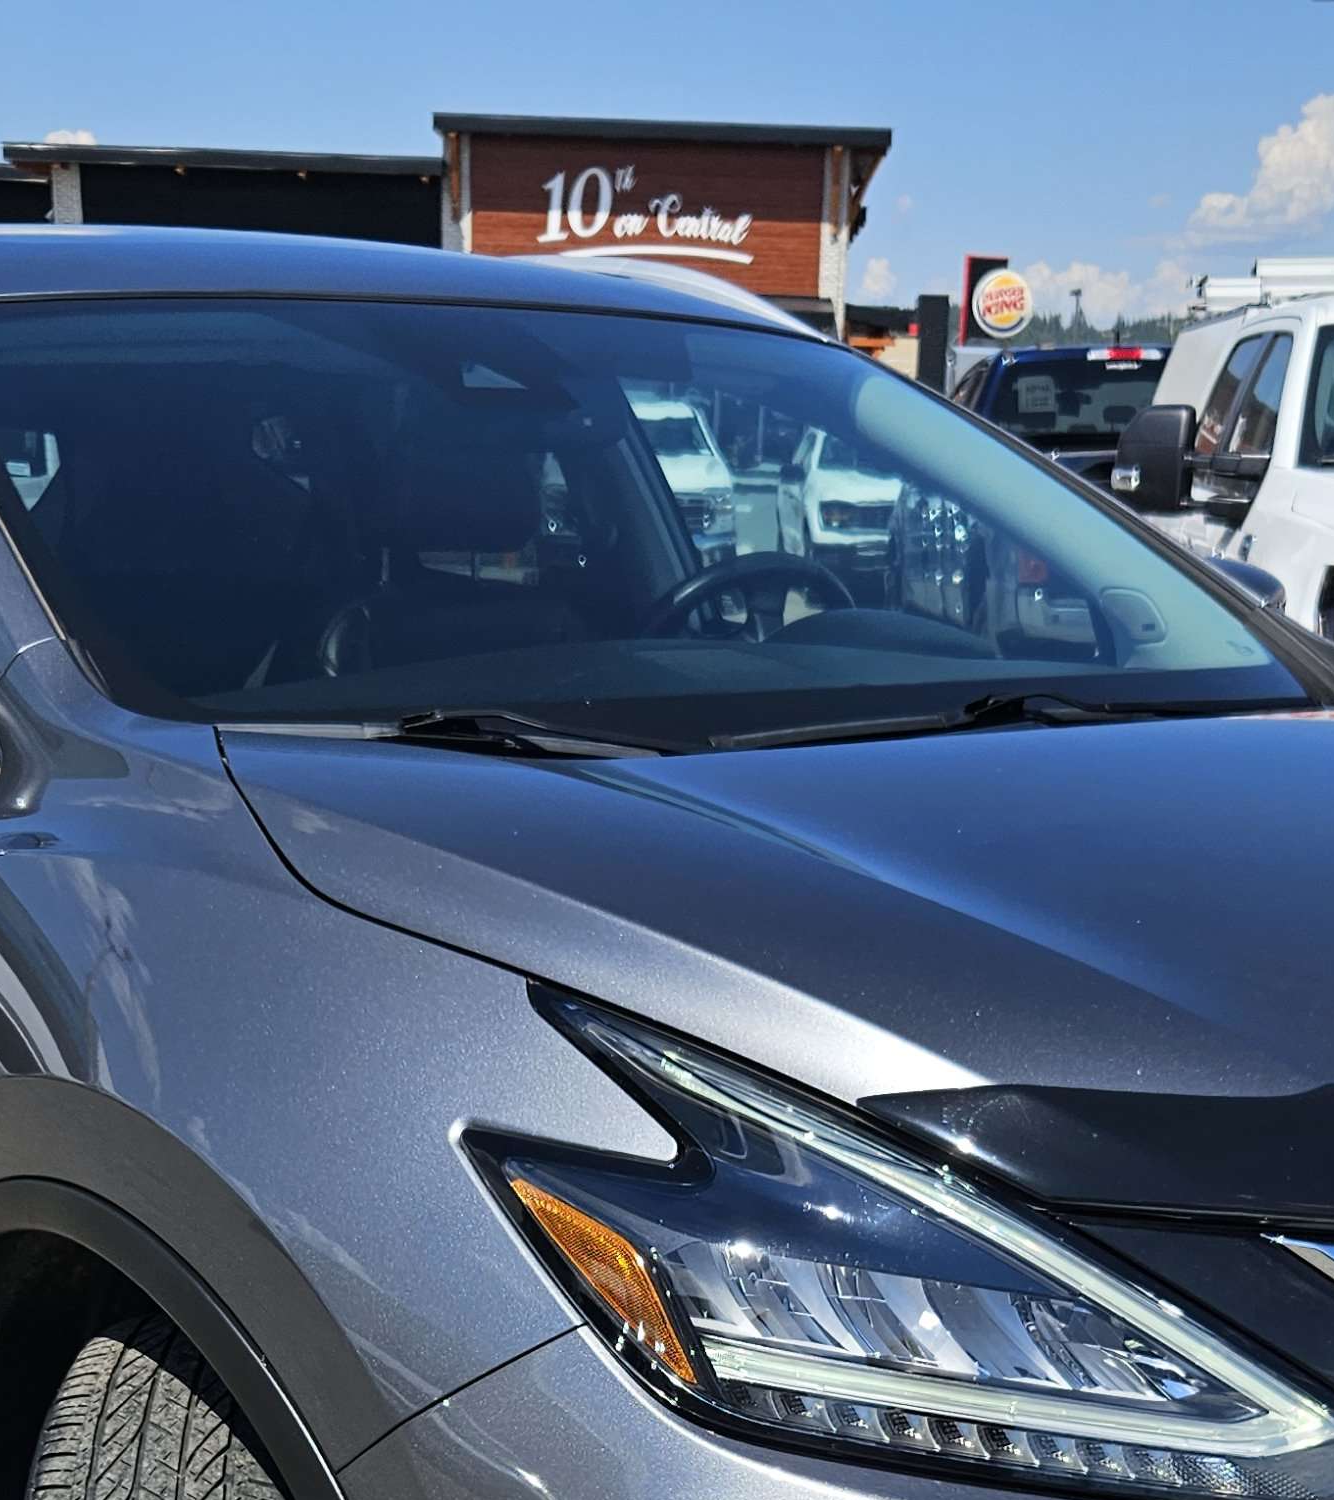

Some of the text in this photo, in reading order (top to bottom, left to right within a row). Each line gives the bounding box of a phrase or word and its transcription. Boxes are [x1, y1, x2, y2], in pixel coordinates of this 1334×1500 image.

[613, 193, 753, 246] on Central
[981, 295, 1026, 318] KING
